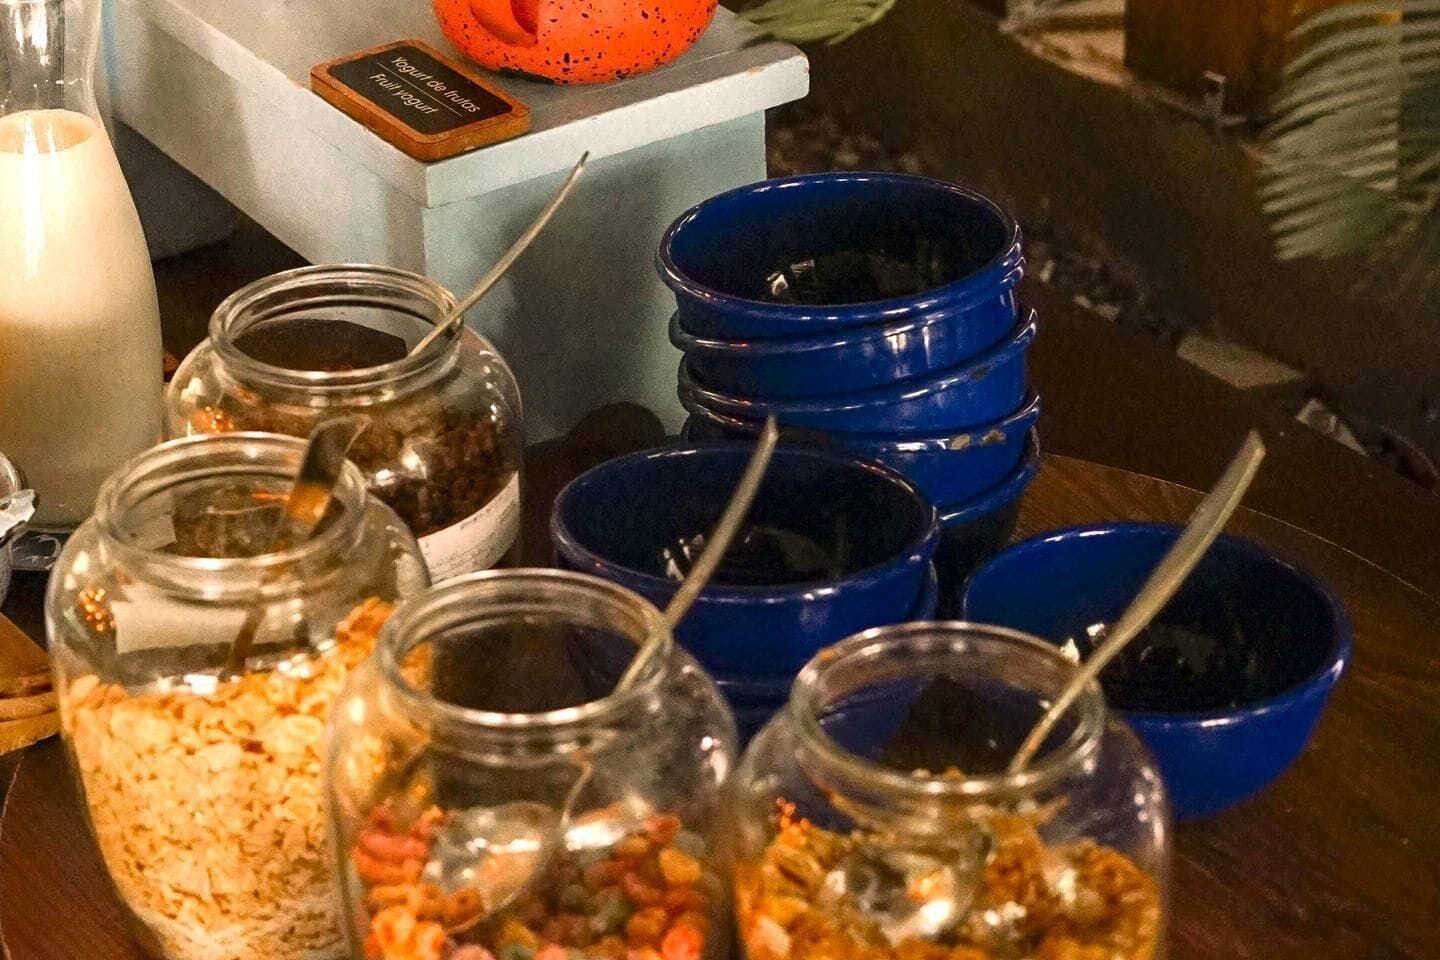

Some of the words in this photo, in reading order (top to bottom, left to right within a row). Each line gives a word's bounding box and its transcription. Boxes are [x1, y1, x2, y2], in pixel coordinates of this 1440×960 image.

[368, 72, 396, 91] Fruit
[393, 84, 439, 115] yogurt
[391, 56, 429, 82] Yogurt
[427, 77, 447, 92] de
[444, 88, 481, 113] frutas
